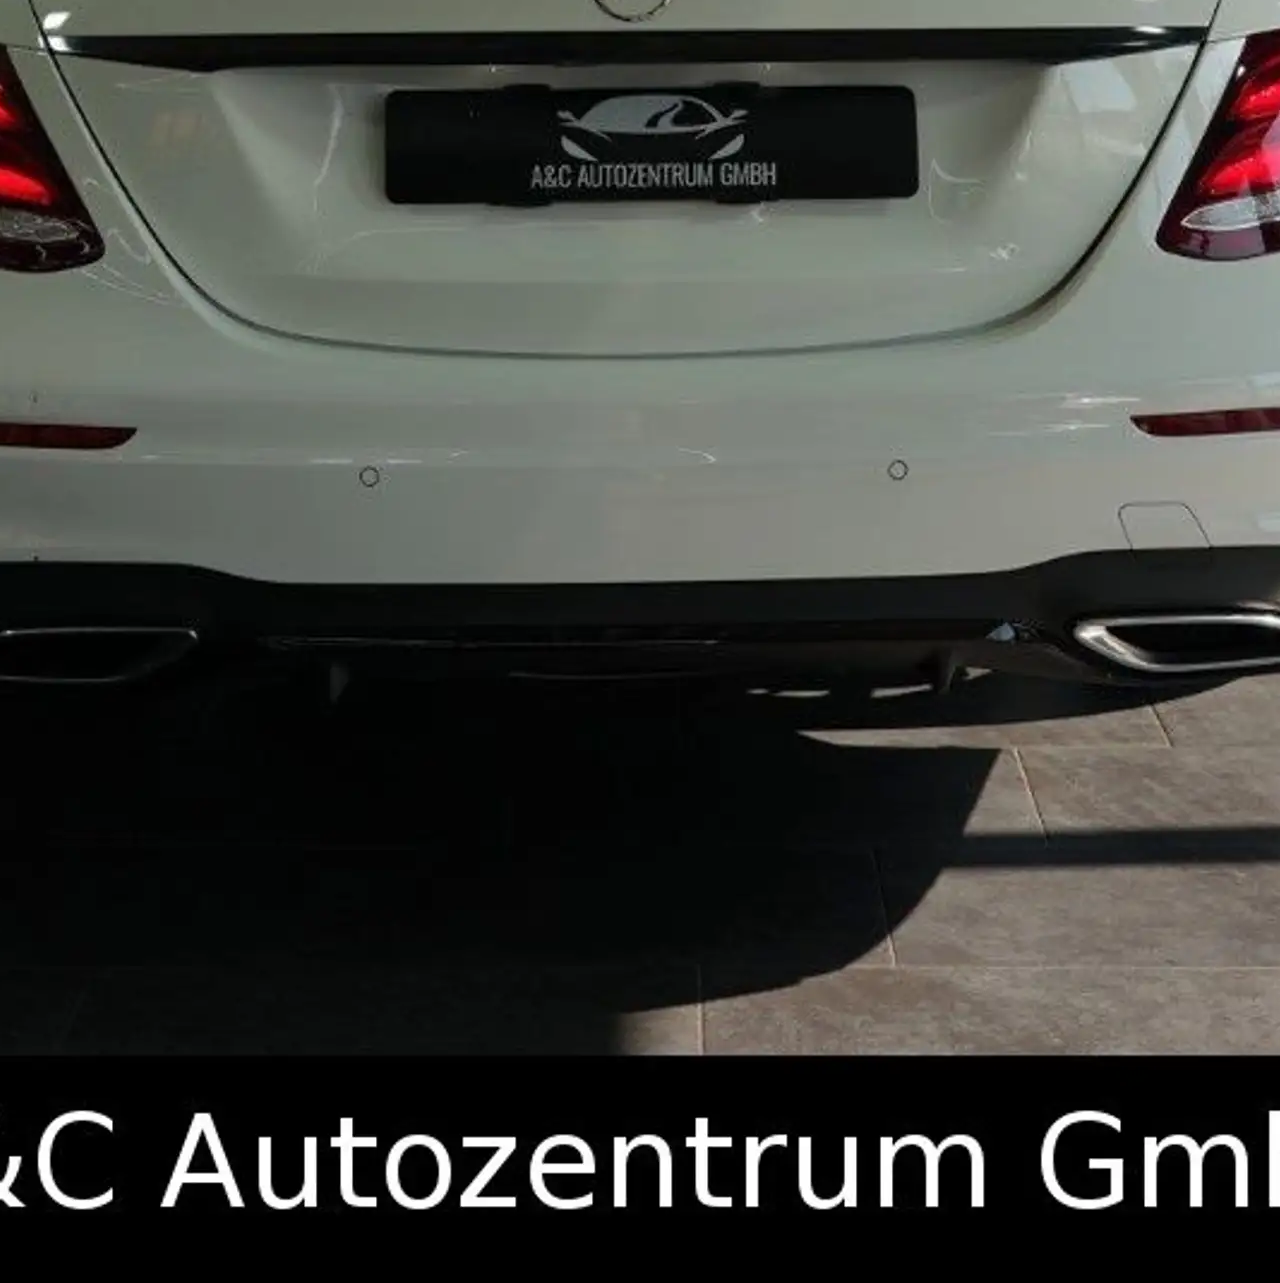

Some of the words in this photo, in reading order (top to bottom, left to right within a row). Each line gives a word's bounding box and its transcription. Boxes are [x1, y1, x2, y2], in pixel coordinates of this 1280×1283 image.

[530, 164, 572, 188] A&C
[577, 162, 713, 188] AUTOZENTRUM
[719, 162, 777, 186] GMBH
